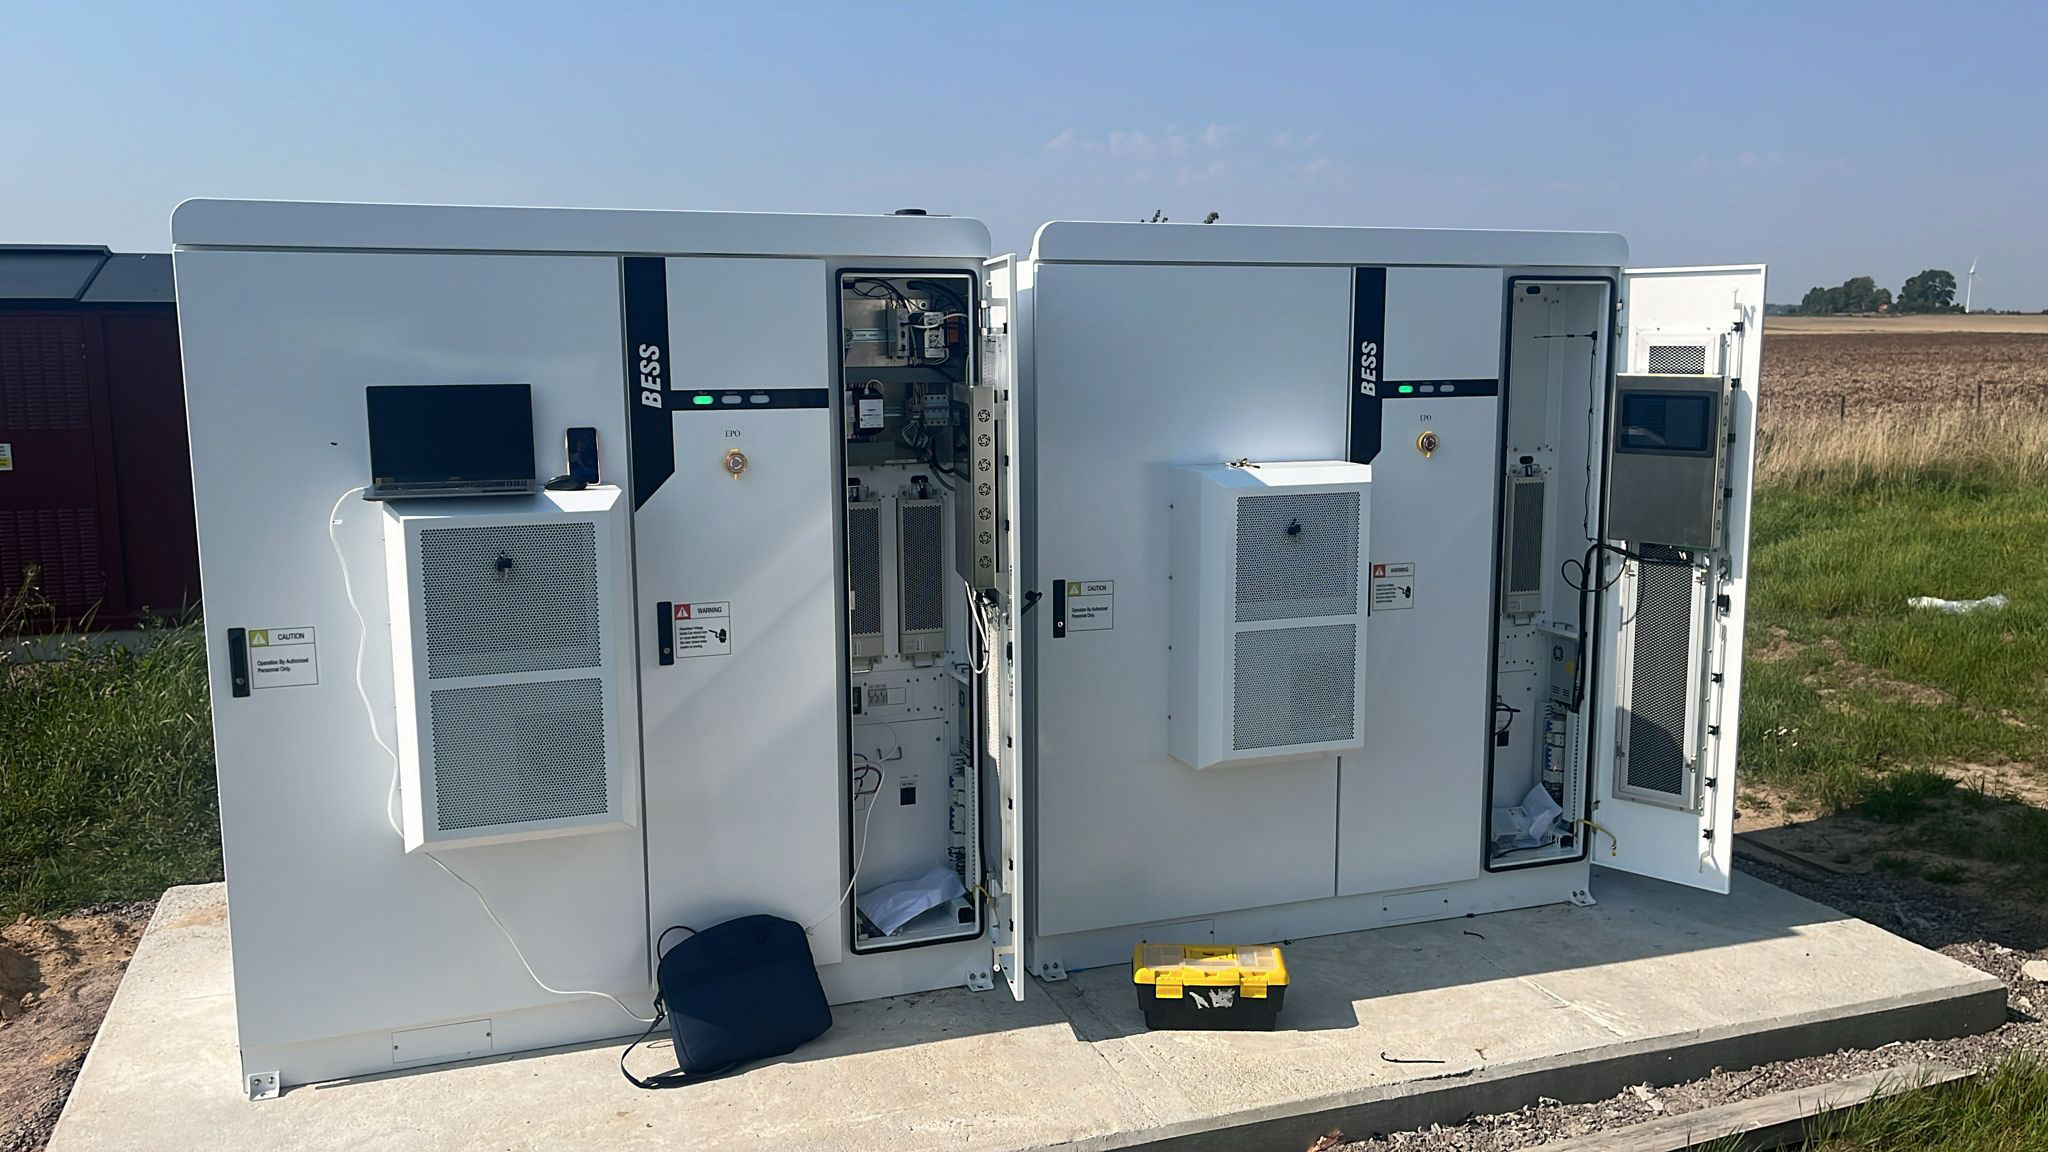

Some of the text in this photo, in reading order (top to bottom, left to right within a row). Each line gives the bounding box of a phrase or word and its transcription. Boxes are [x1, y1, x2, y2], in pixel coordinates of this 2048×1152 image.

[1360, 341, 1377, 397] BESS
[638, 343, 663, 409] BESS
[1419, 414, 1432, 422] EPO
[725, 429, 741, 438] EPO
[697, 606, 722, 614] WARNING
[277, 632, 305, 641] CAUTION
